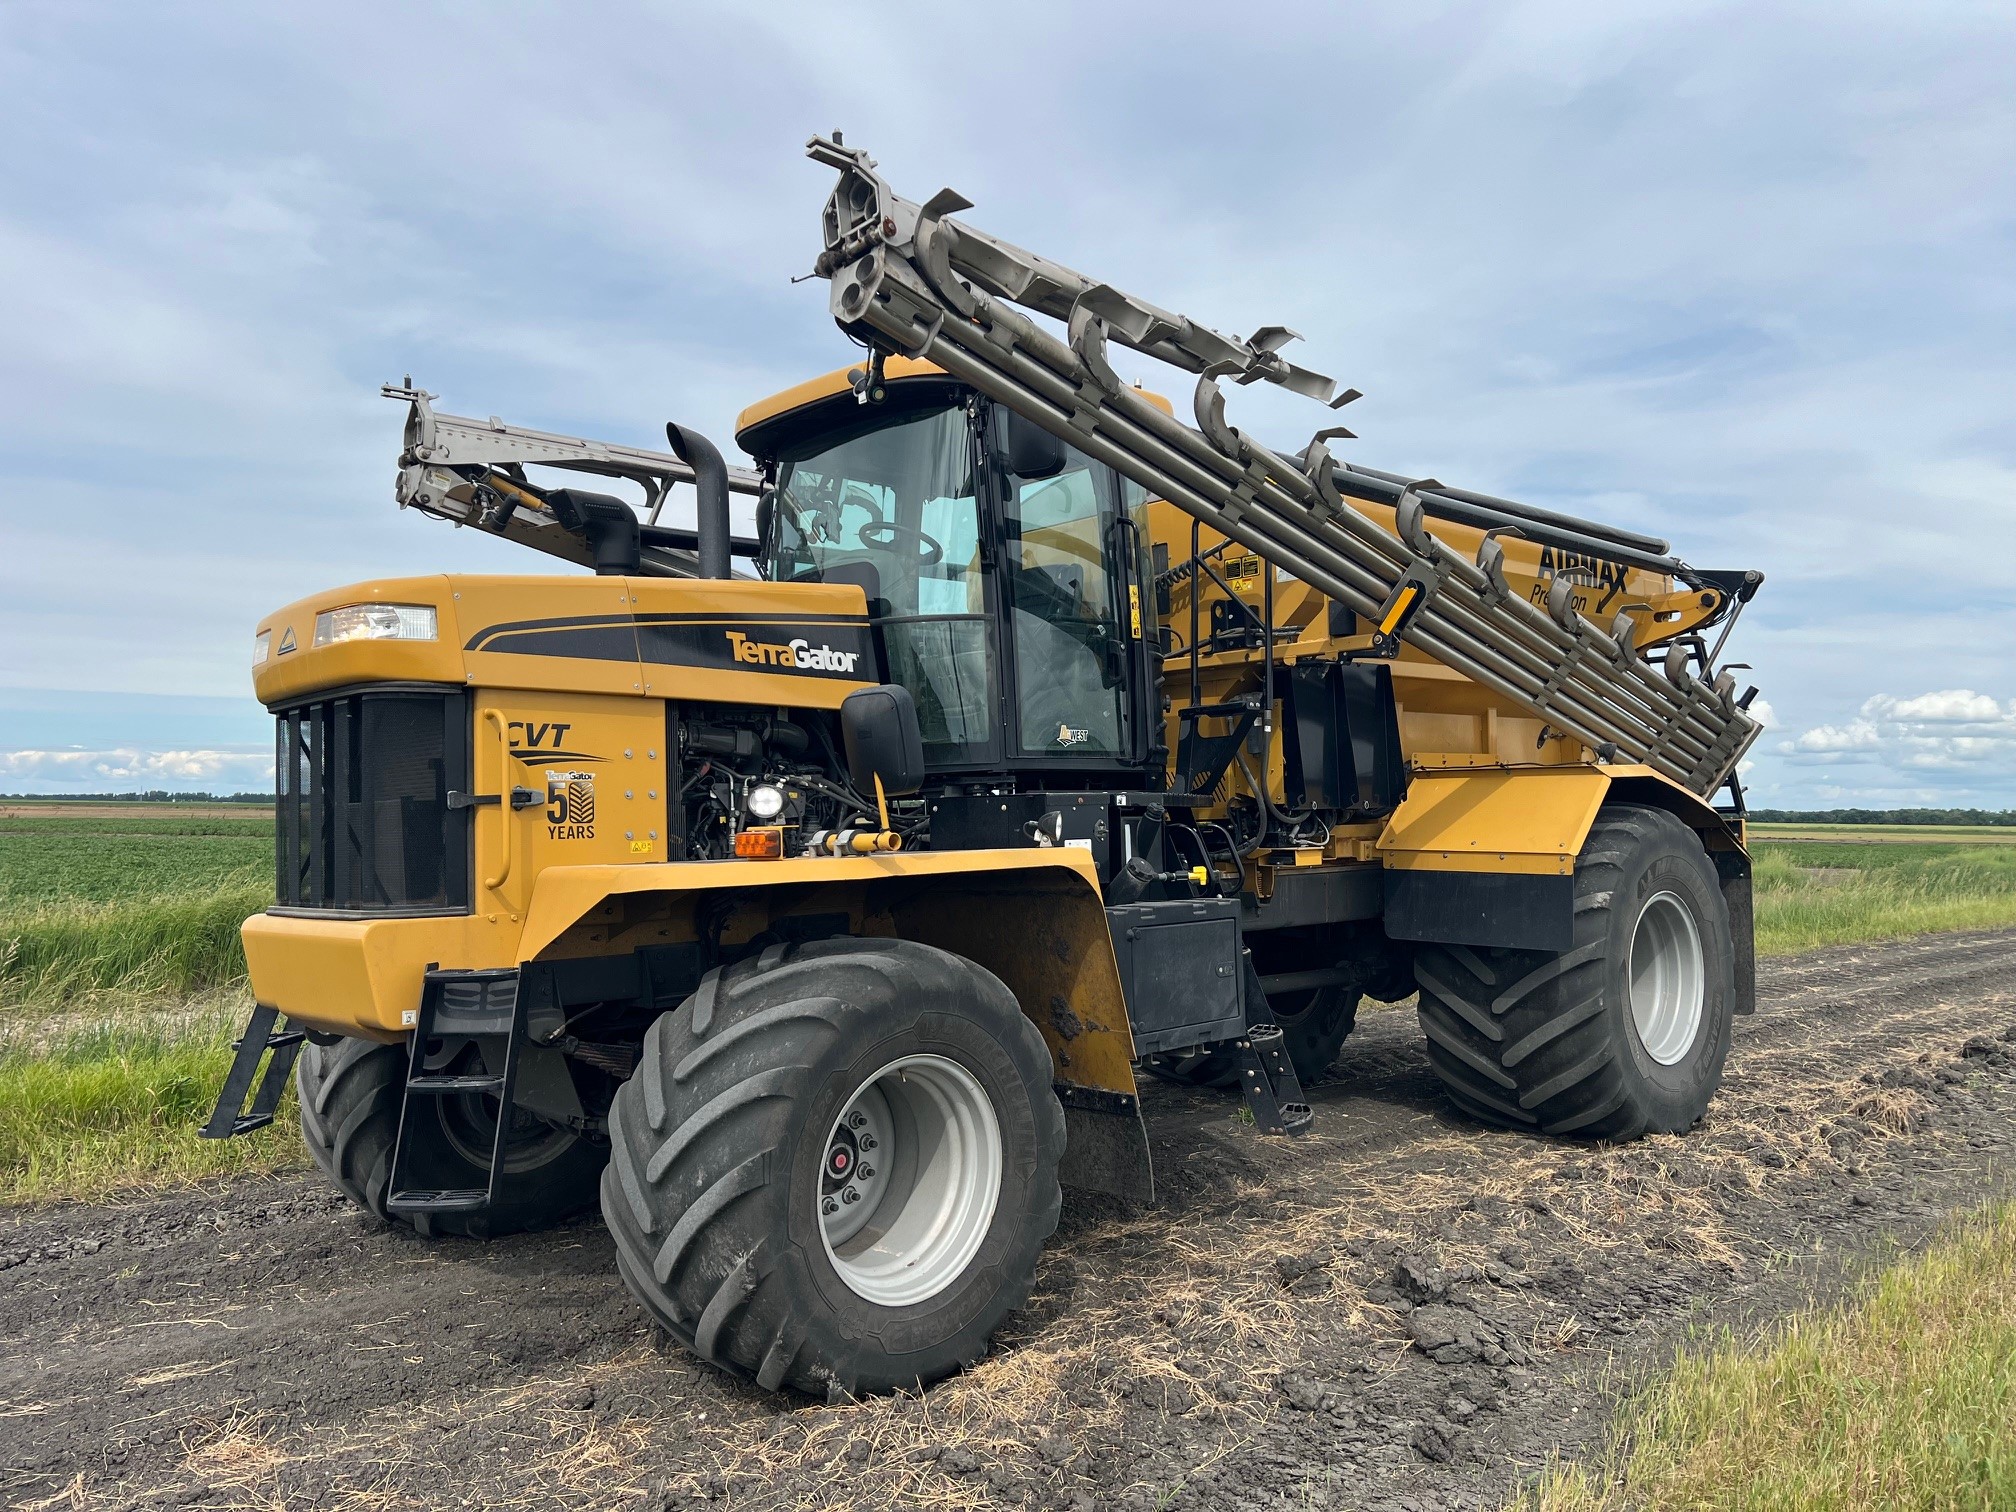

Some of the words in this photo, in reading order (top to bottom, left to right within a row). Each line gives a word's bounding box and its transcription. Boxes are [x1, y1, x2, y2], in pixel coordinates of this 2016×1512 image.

[1537, 545, 1629, 608] AIRMAX
[726, 631, 858, 672] TerraGator
[546, 770, 594, 780] TerraGator
[548, 825, 595, 840] YEARS
